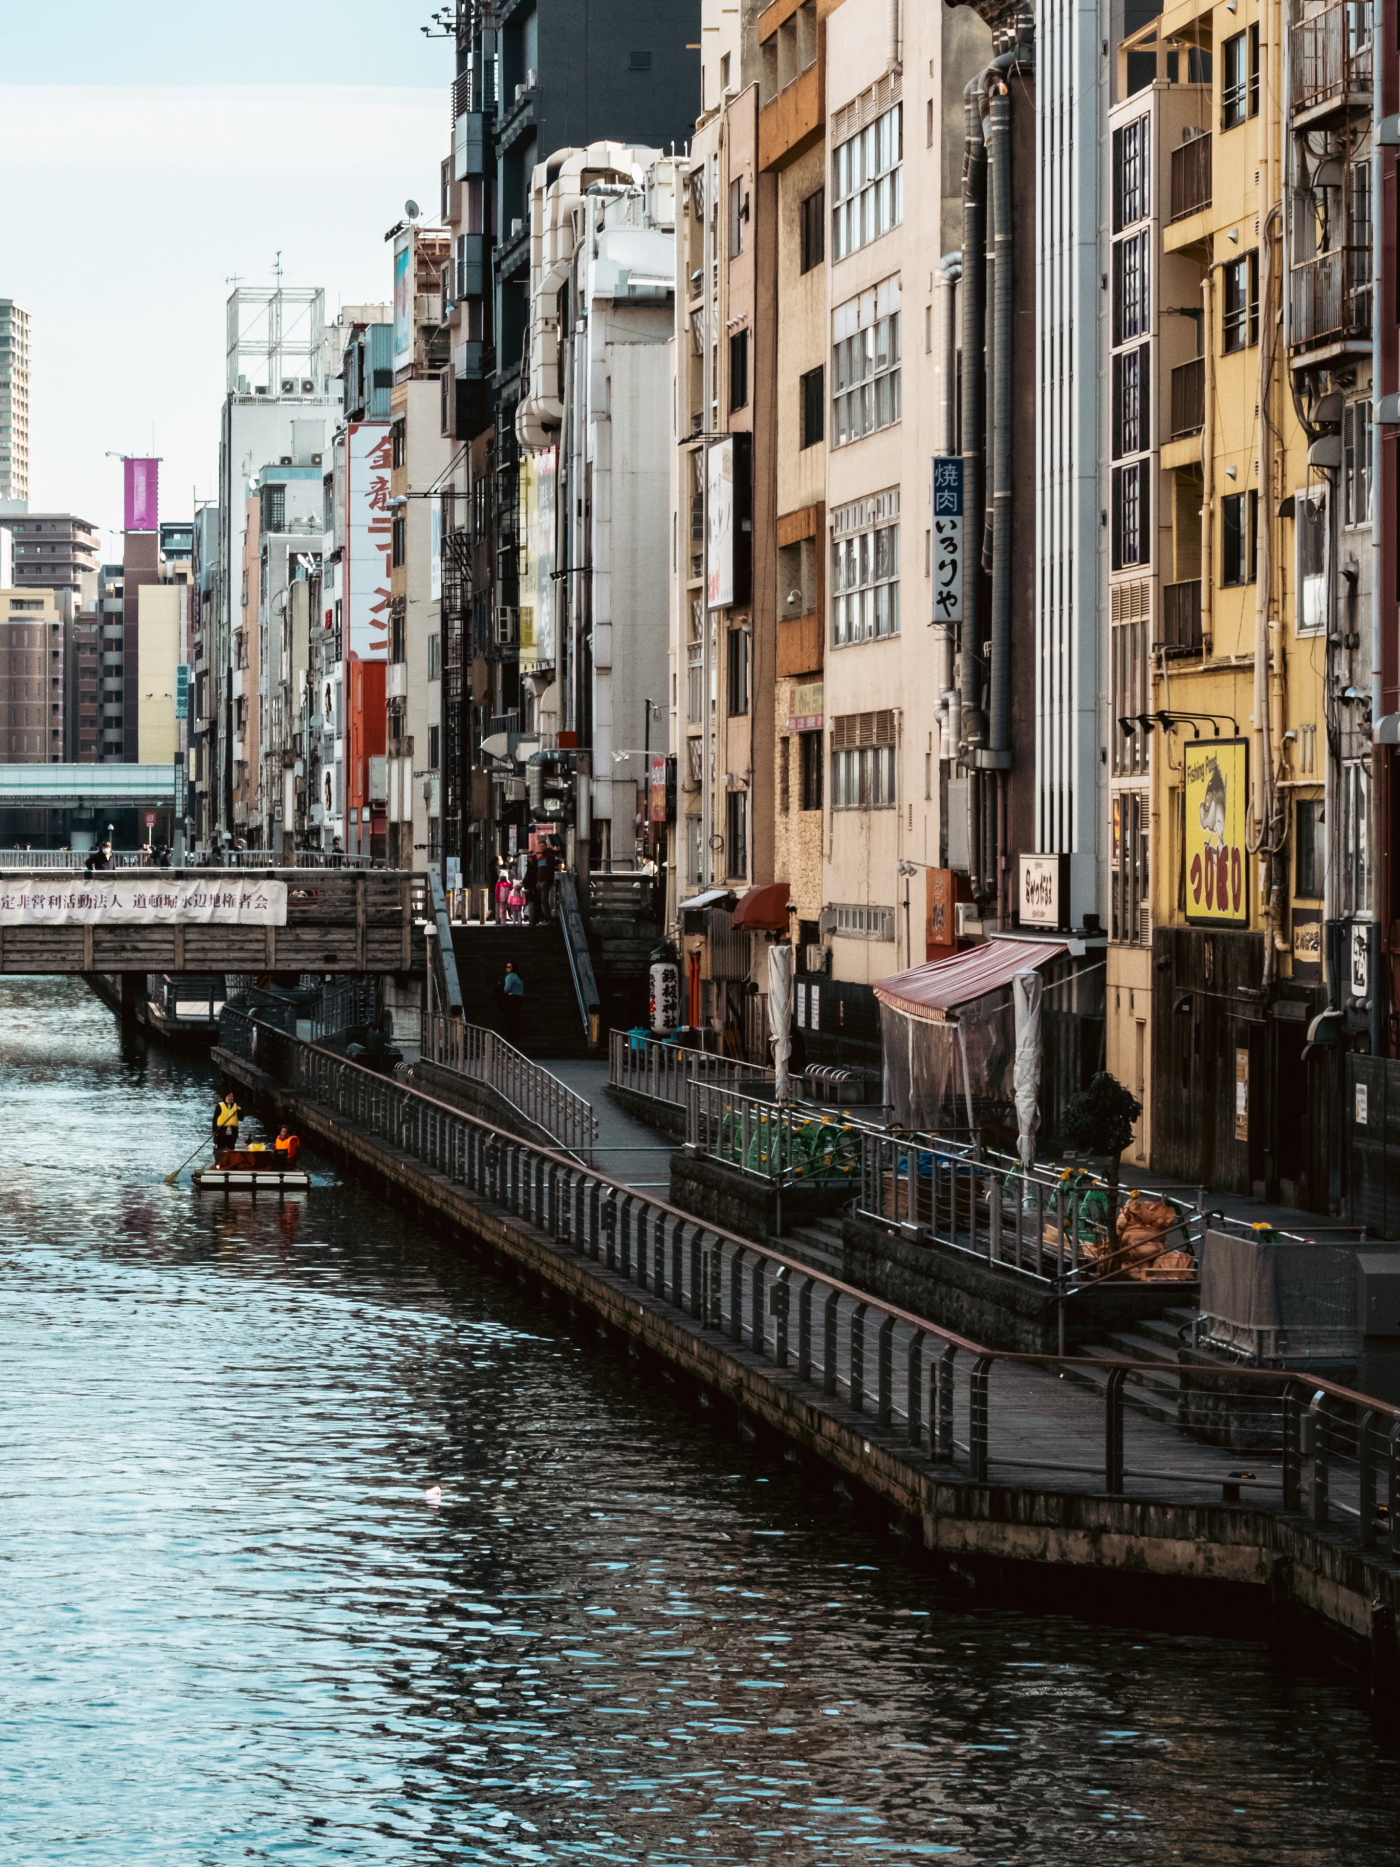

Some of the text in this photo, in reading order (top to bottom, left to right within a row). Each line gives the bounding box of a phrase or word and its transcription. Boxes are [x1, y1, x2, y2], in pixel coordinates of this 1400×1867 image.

[935, 463, 958, 512] 焼肉
[935, 519, 958, 618] いろりや
[132, 893, 268, 909] 道頓堀水辺地権者会
[662, 969, 677, 1028] 鉄板神社
